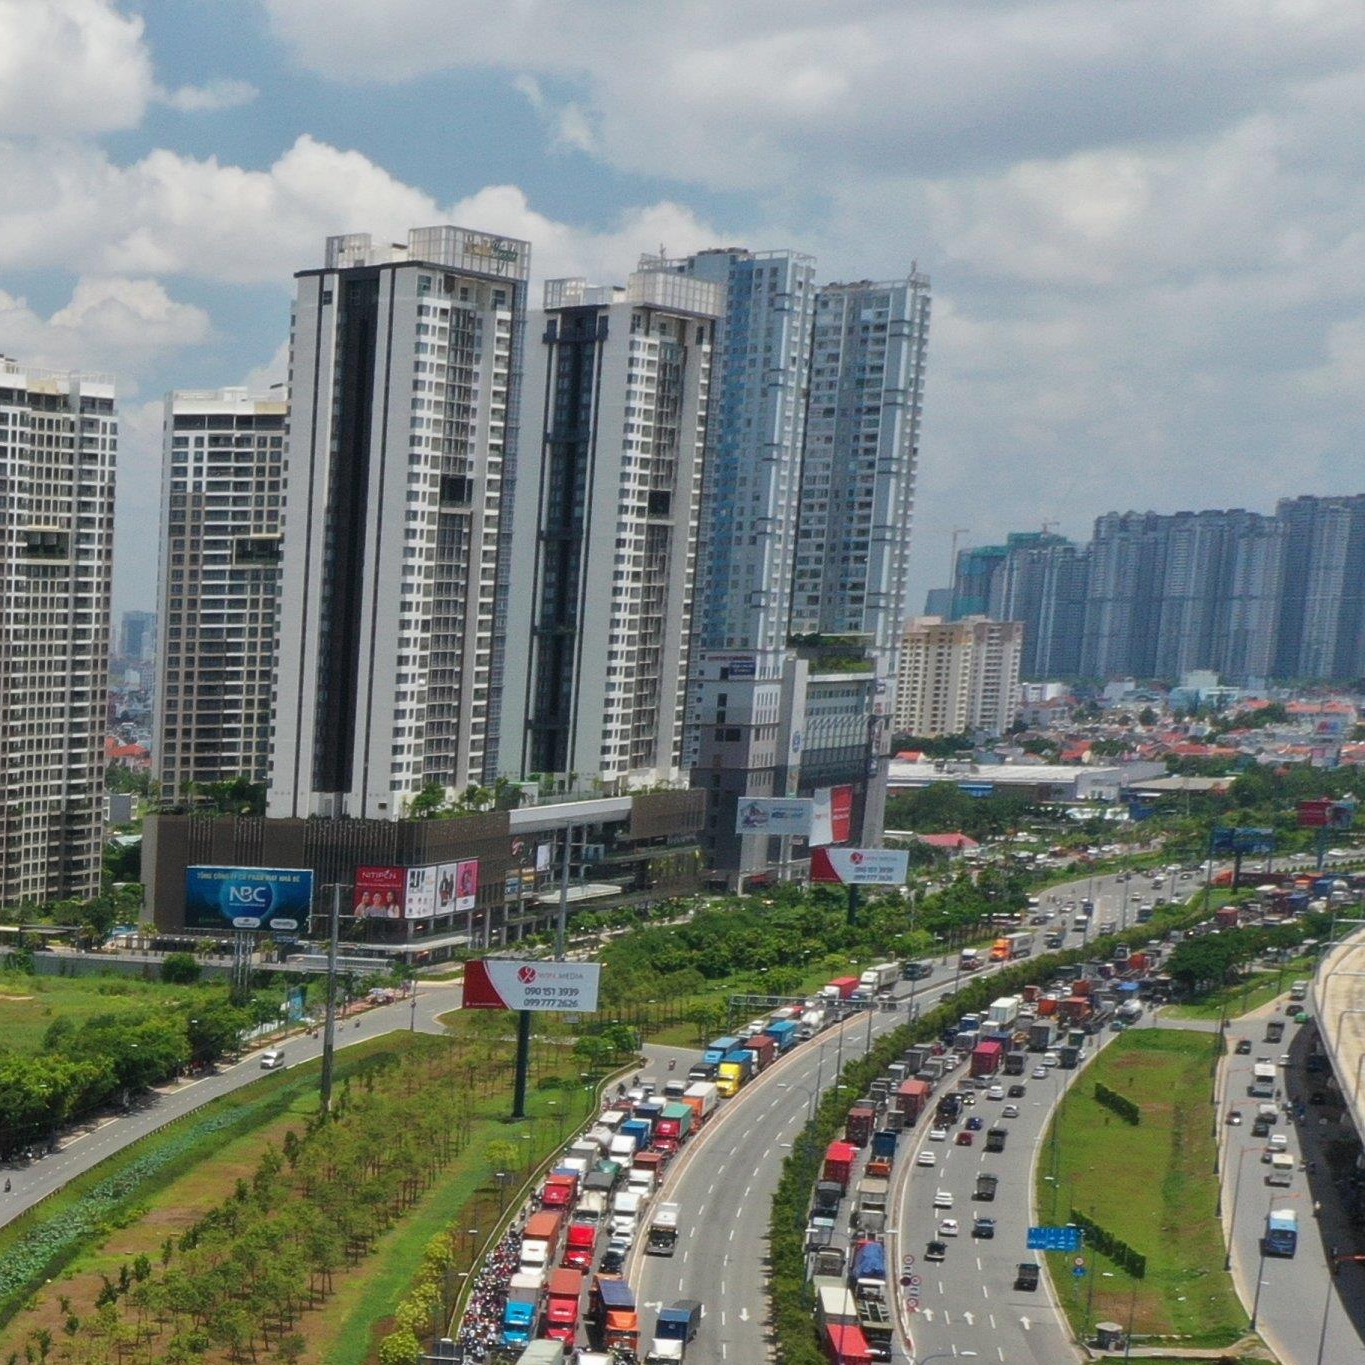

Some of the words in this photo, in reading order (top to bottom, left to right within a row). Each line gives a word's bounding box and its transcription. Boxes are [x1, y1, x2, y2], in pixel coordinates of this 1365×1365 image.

[229, 886, 266, 902] NBC
[524, 987, 541, 995] 090
[558, 988, 579, 996] 3939
